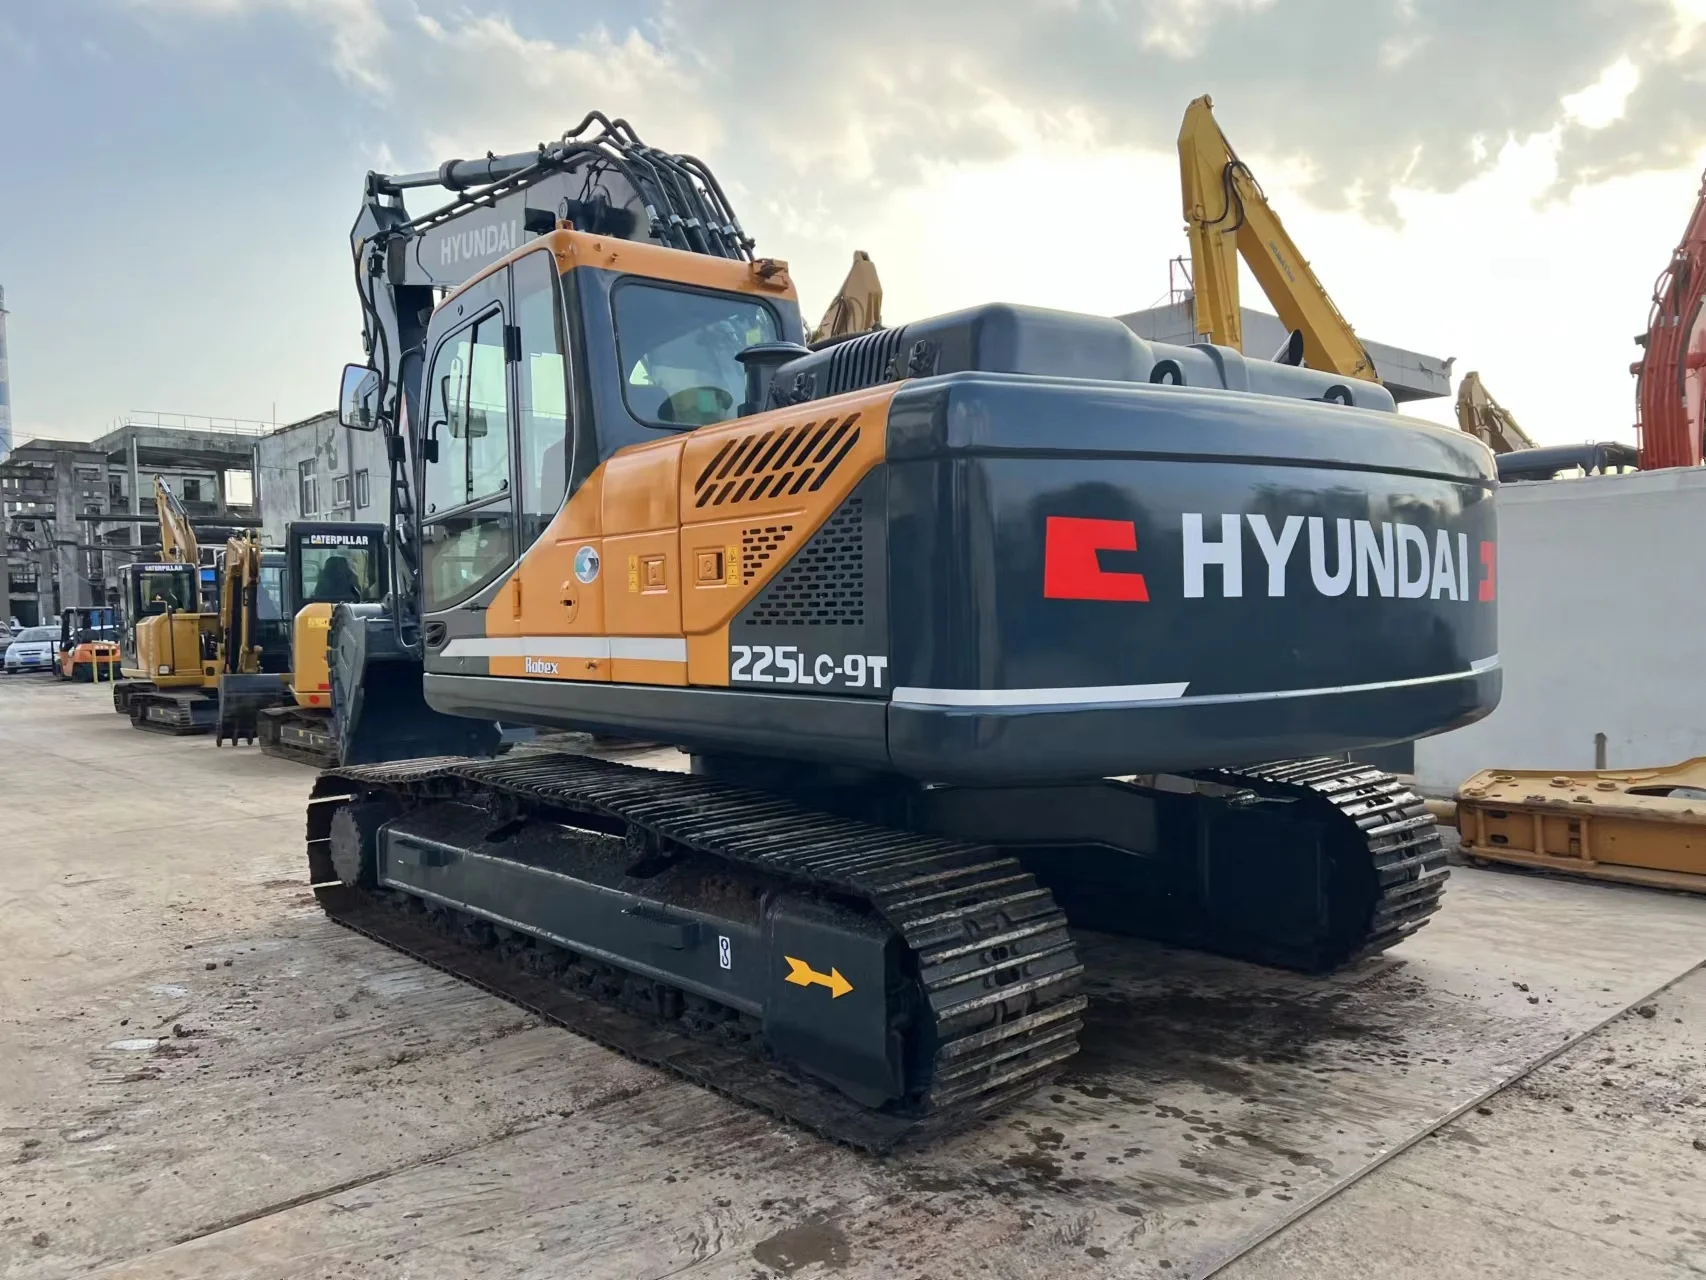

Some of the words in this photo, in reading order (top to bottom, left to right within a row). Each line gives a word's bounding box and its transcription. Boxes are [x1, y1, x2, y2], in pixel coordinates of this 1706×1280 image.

[441, 220, 516, 265] HYUNDAI
[311, 535, 368, 545] CATERPILLAR
[1182, 513, 1469, 600] HYUNDAI
[525, 656, 559, 674] Robex
[732, 645, 887, 688] 225LC-9T
